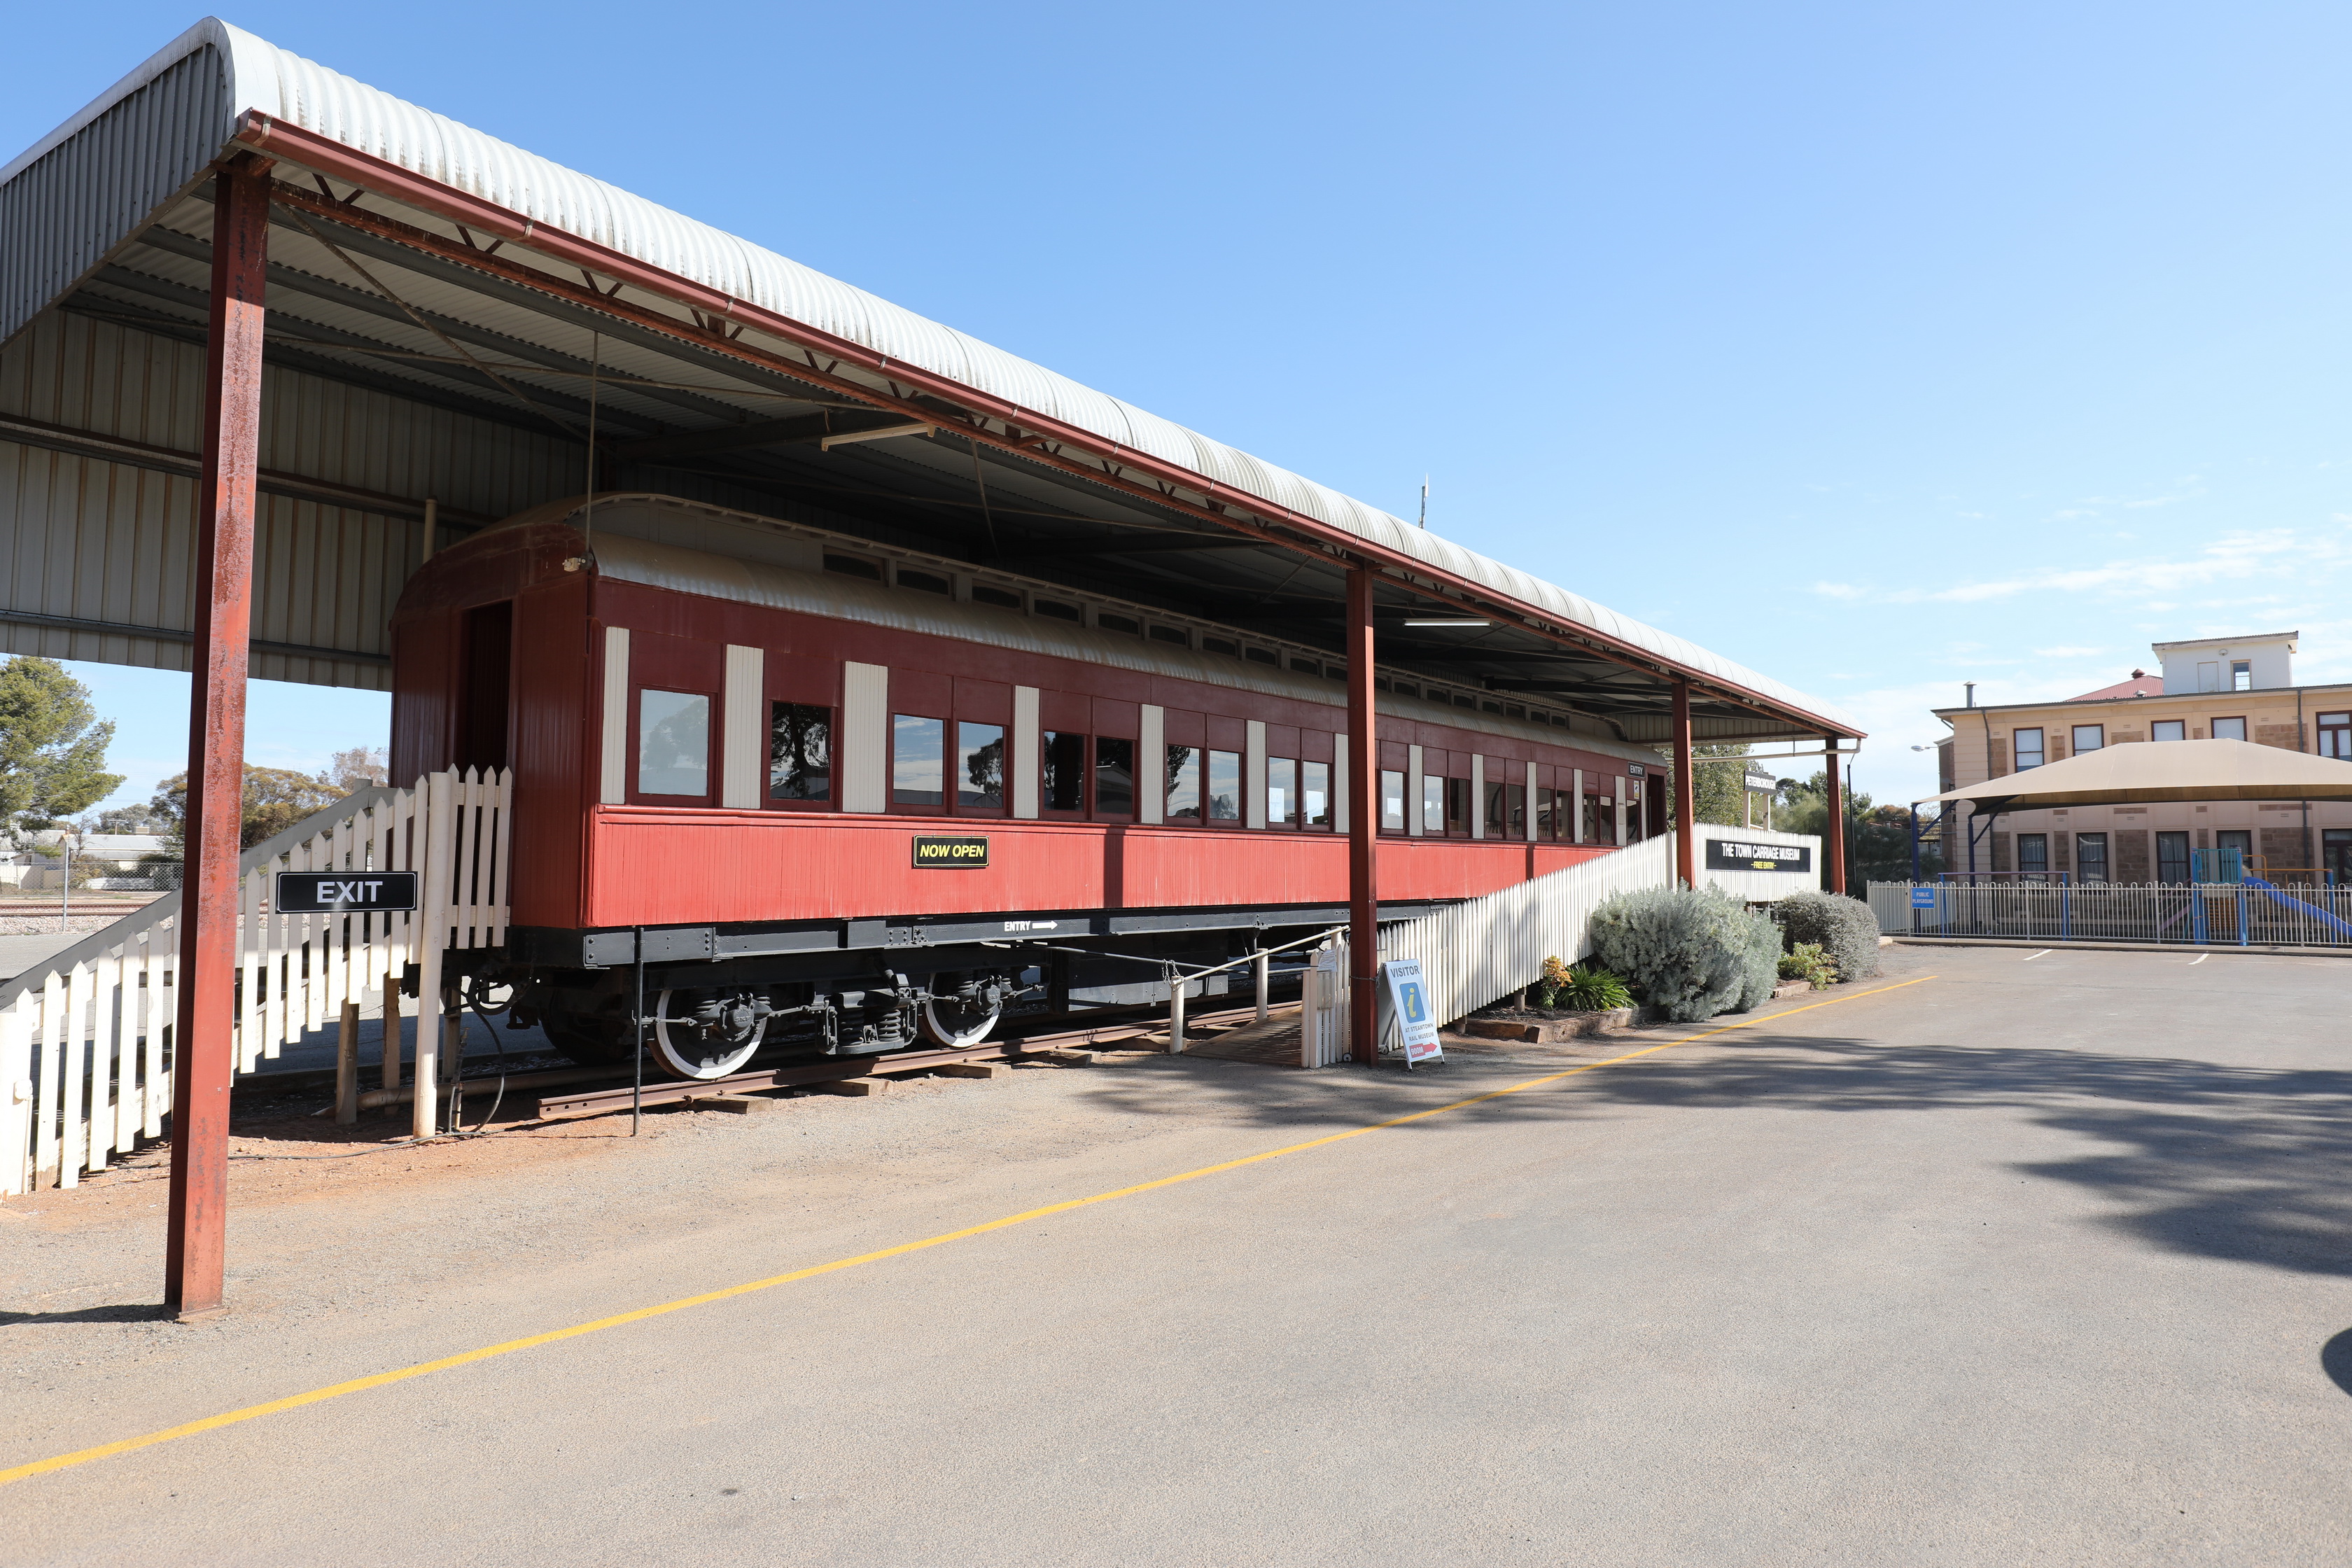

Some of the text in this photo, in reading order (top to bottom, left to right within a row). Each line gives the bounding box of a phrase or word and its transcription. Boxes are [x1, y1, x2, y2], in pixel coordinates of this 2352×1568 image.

[1630, 764, 1644, 776] ENTRY
[1745, 775, 1776, 790] PETERBOROUGH
[920, 845, 984, 858] NOW OPEN
[1721, 843, 1800, 860] THE TOWN CARRIAGE MUSEUM
[316, 881, 383, 903] EXIT
[1004, 920, 1030, 932] ENTRY
[1390, 965, 1420, 978] VISITOR
[1410, 1023, 1434, 1032] STEAMTOWN
[1410, 1046, 1424, 1055] 900M
